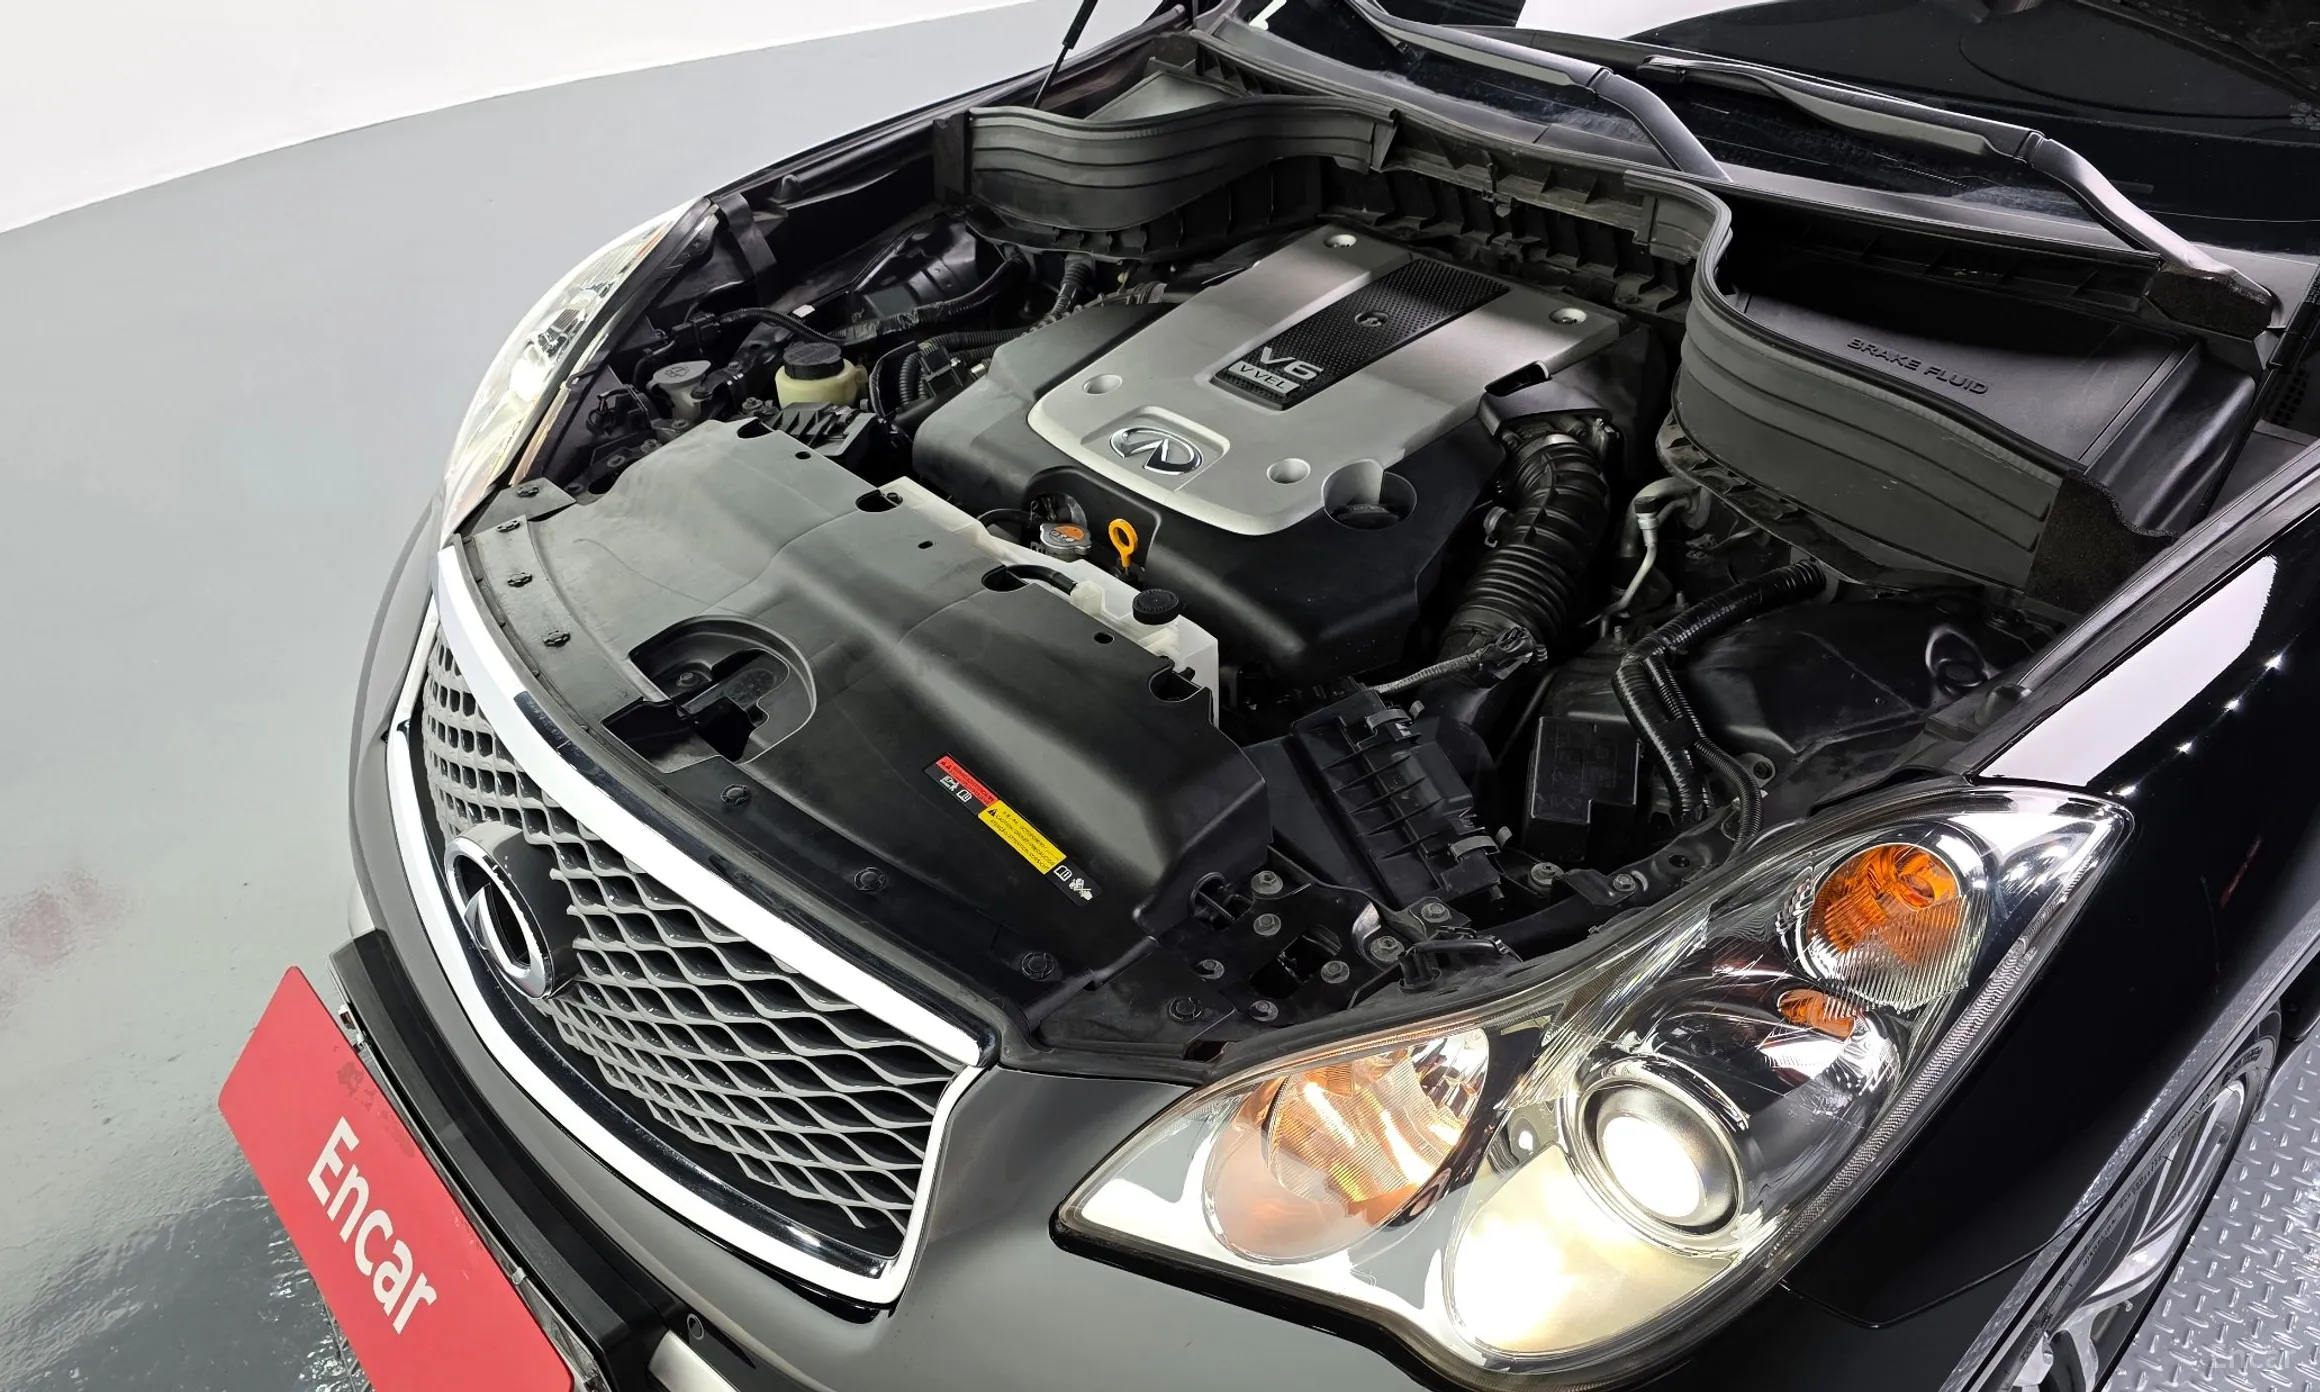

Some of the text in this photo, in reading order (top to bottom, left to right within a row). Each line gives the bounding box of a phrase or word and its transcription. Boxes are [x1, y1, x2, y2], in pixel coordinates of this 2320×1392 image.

[1240, 364, 1284, 389] VVEL
[1260, 347, 1324, 380] V6
[1847, 338, 1989, 395] BRAKE FLUID
[307, 1116, 438, 1335] Encar
